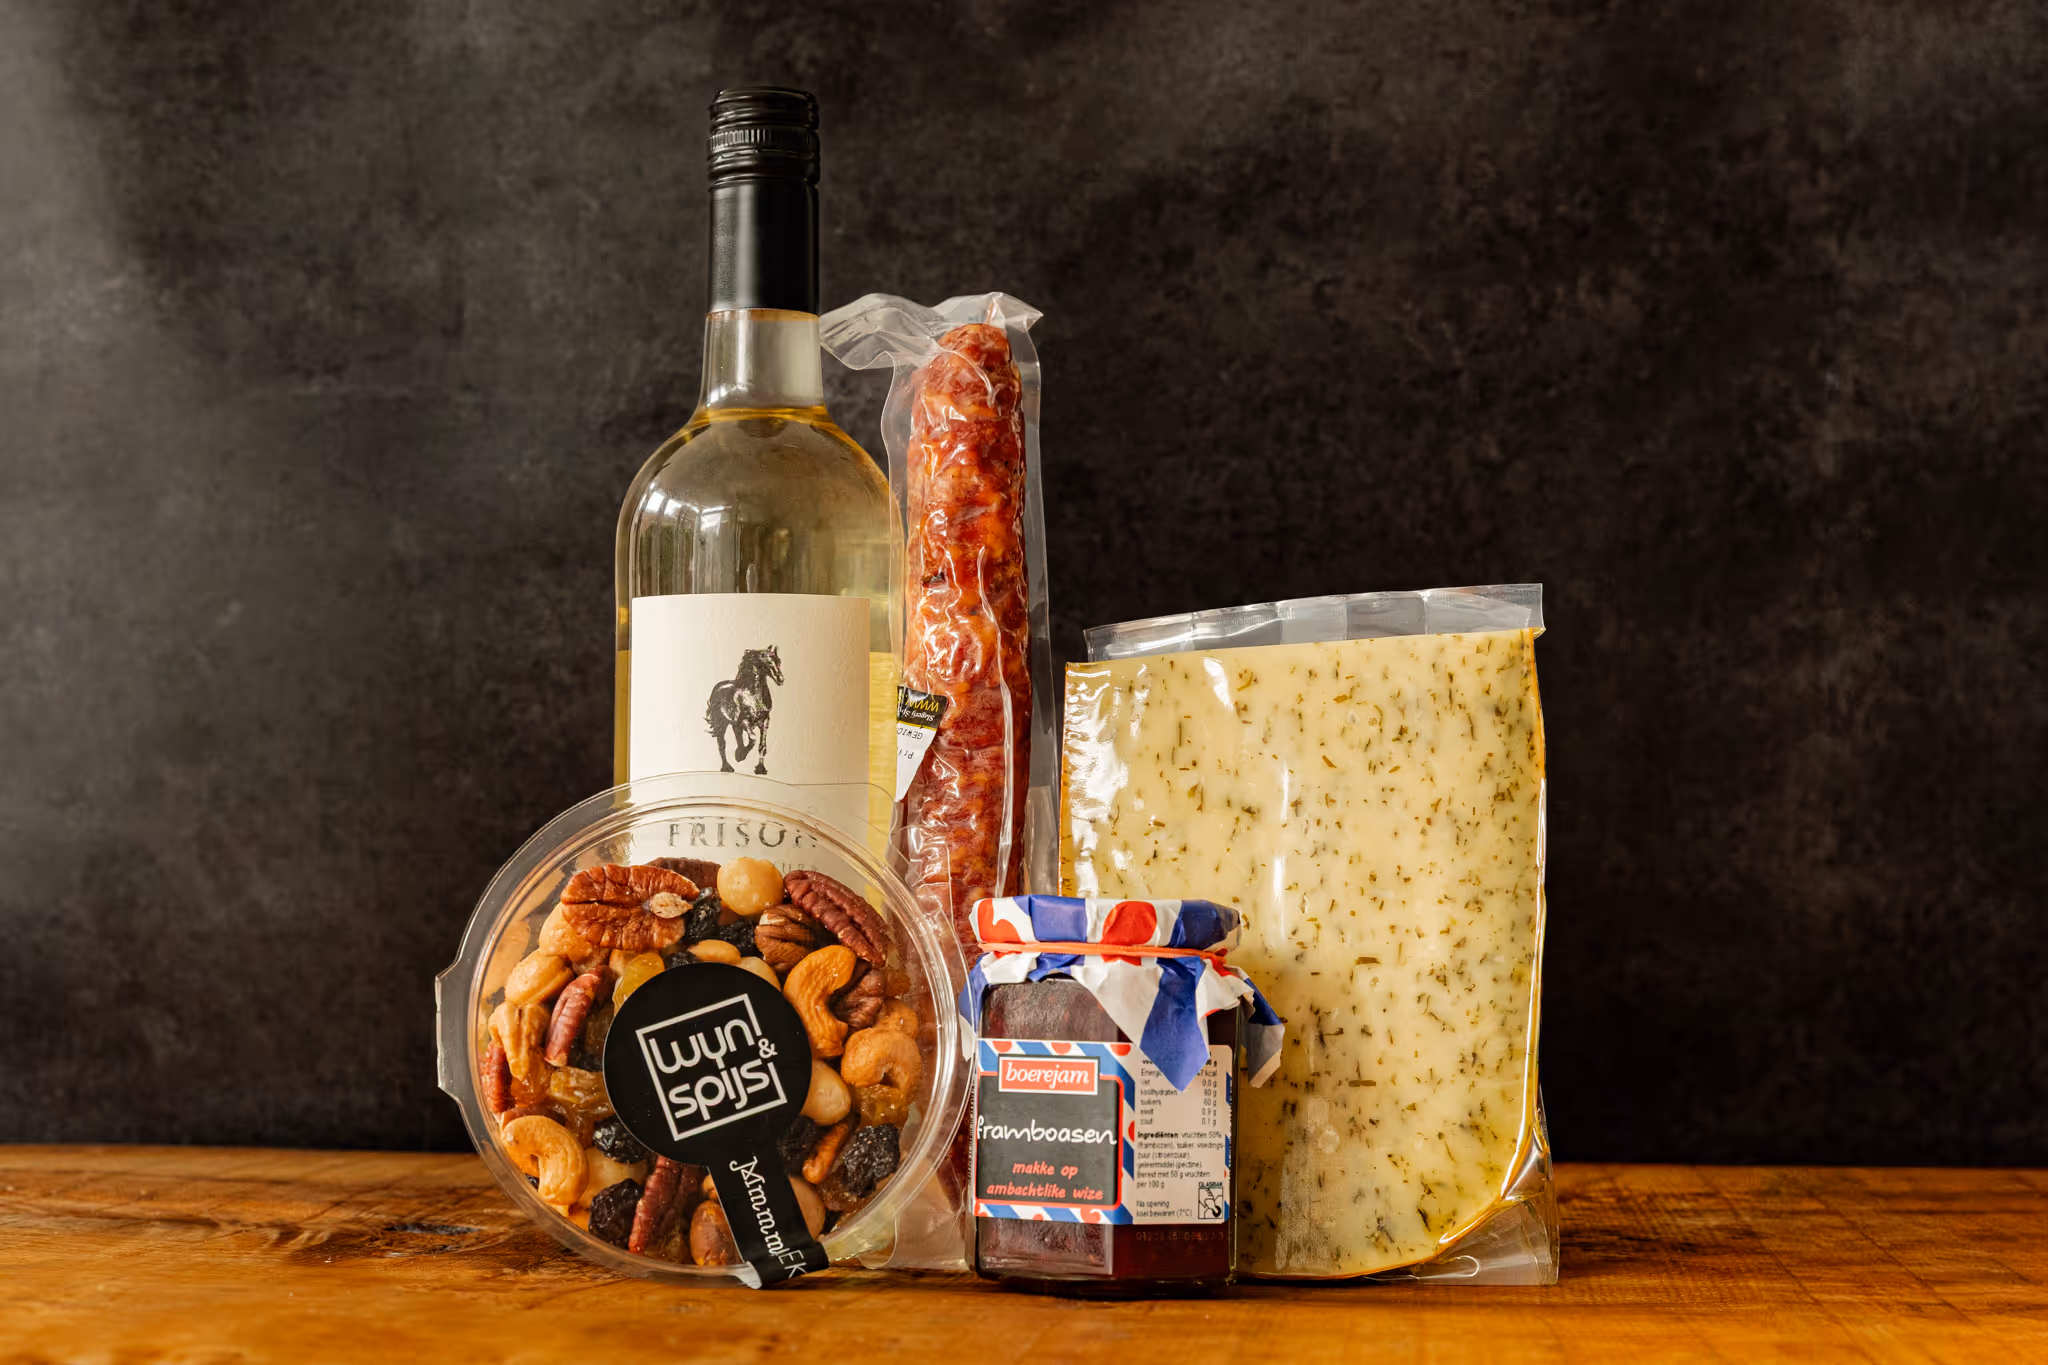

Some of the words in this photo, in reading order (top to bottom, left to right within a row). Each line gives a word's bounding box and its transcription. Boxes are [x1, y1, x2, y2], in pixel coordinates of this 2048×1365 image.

[897, 748, 914, 760] Pri
[649, 1018, 754, 1074] wyn
[758, 1037, 778, 1059] &
[1005, 1061, 1090, 1090] boerejam
[1140, 1068, 1162, 1078] Energ
[667, 1058, 770, 1121] spijs
[976, 1114, 1118, 1146] framboasen
[1181, 1132, 1208, 1140] vruchten
[1012, 1160, 1055, 1176] makke
[1060, 1164, 1078, 1180] op
[1170, 1170, 1178, 1179] 50
[986, 1181, 1067, 1199] ambachtlike
[1072, 1186, 1104, 1201] wize
[1148, 1180, 1160, 1188] 100
[1146, 1200, 1170, 1209] opening
